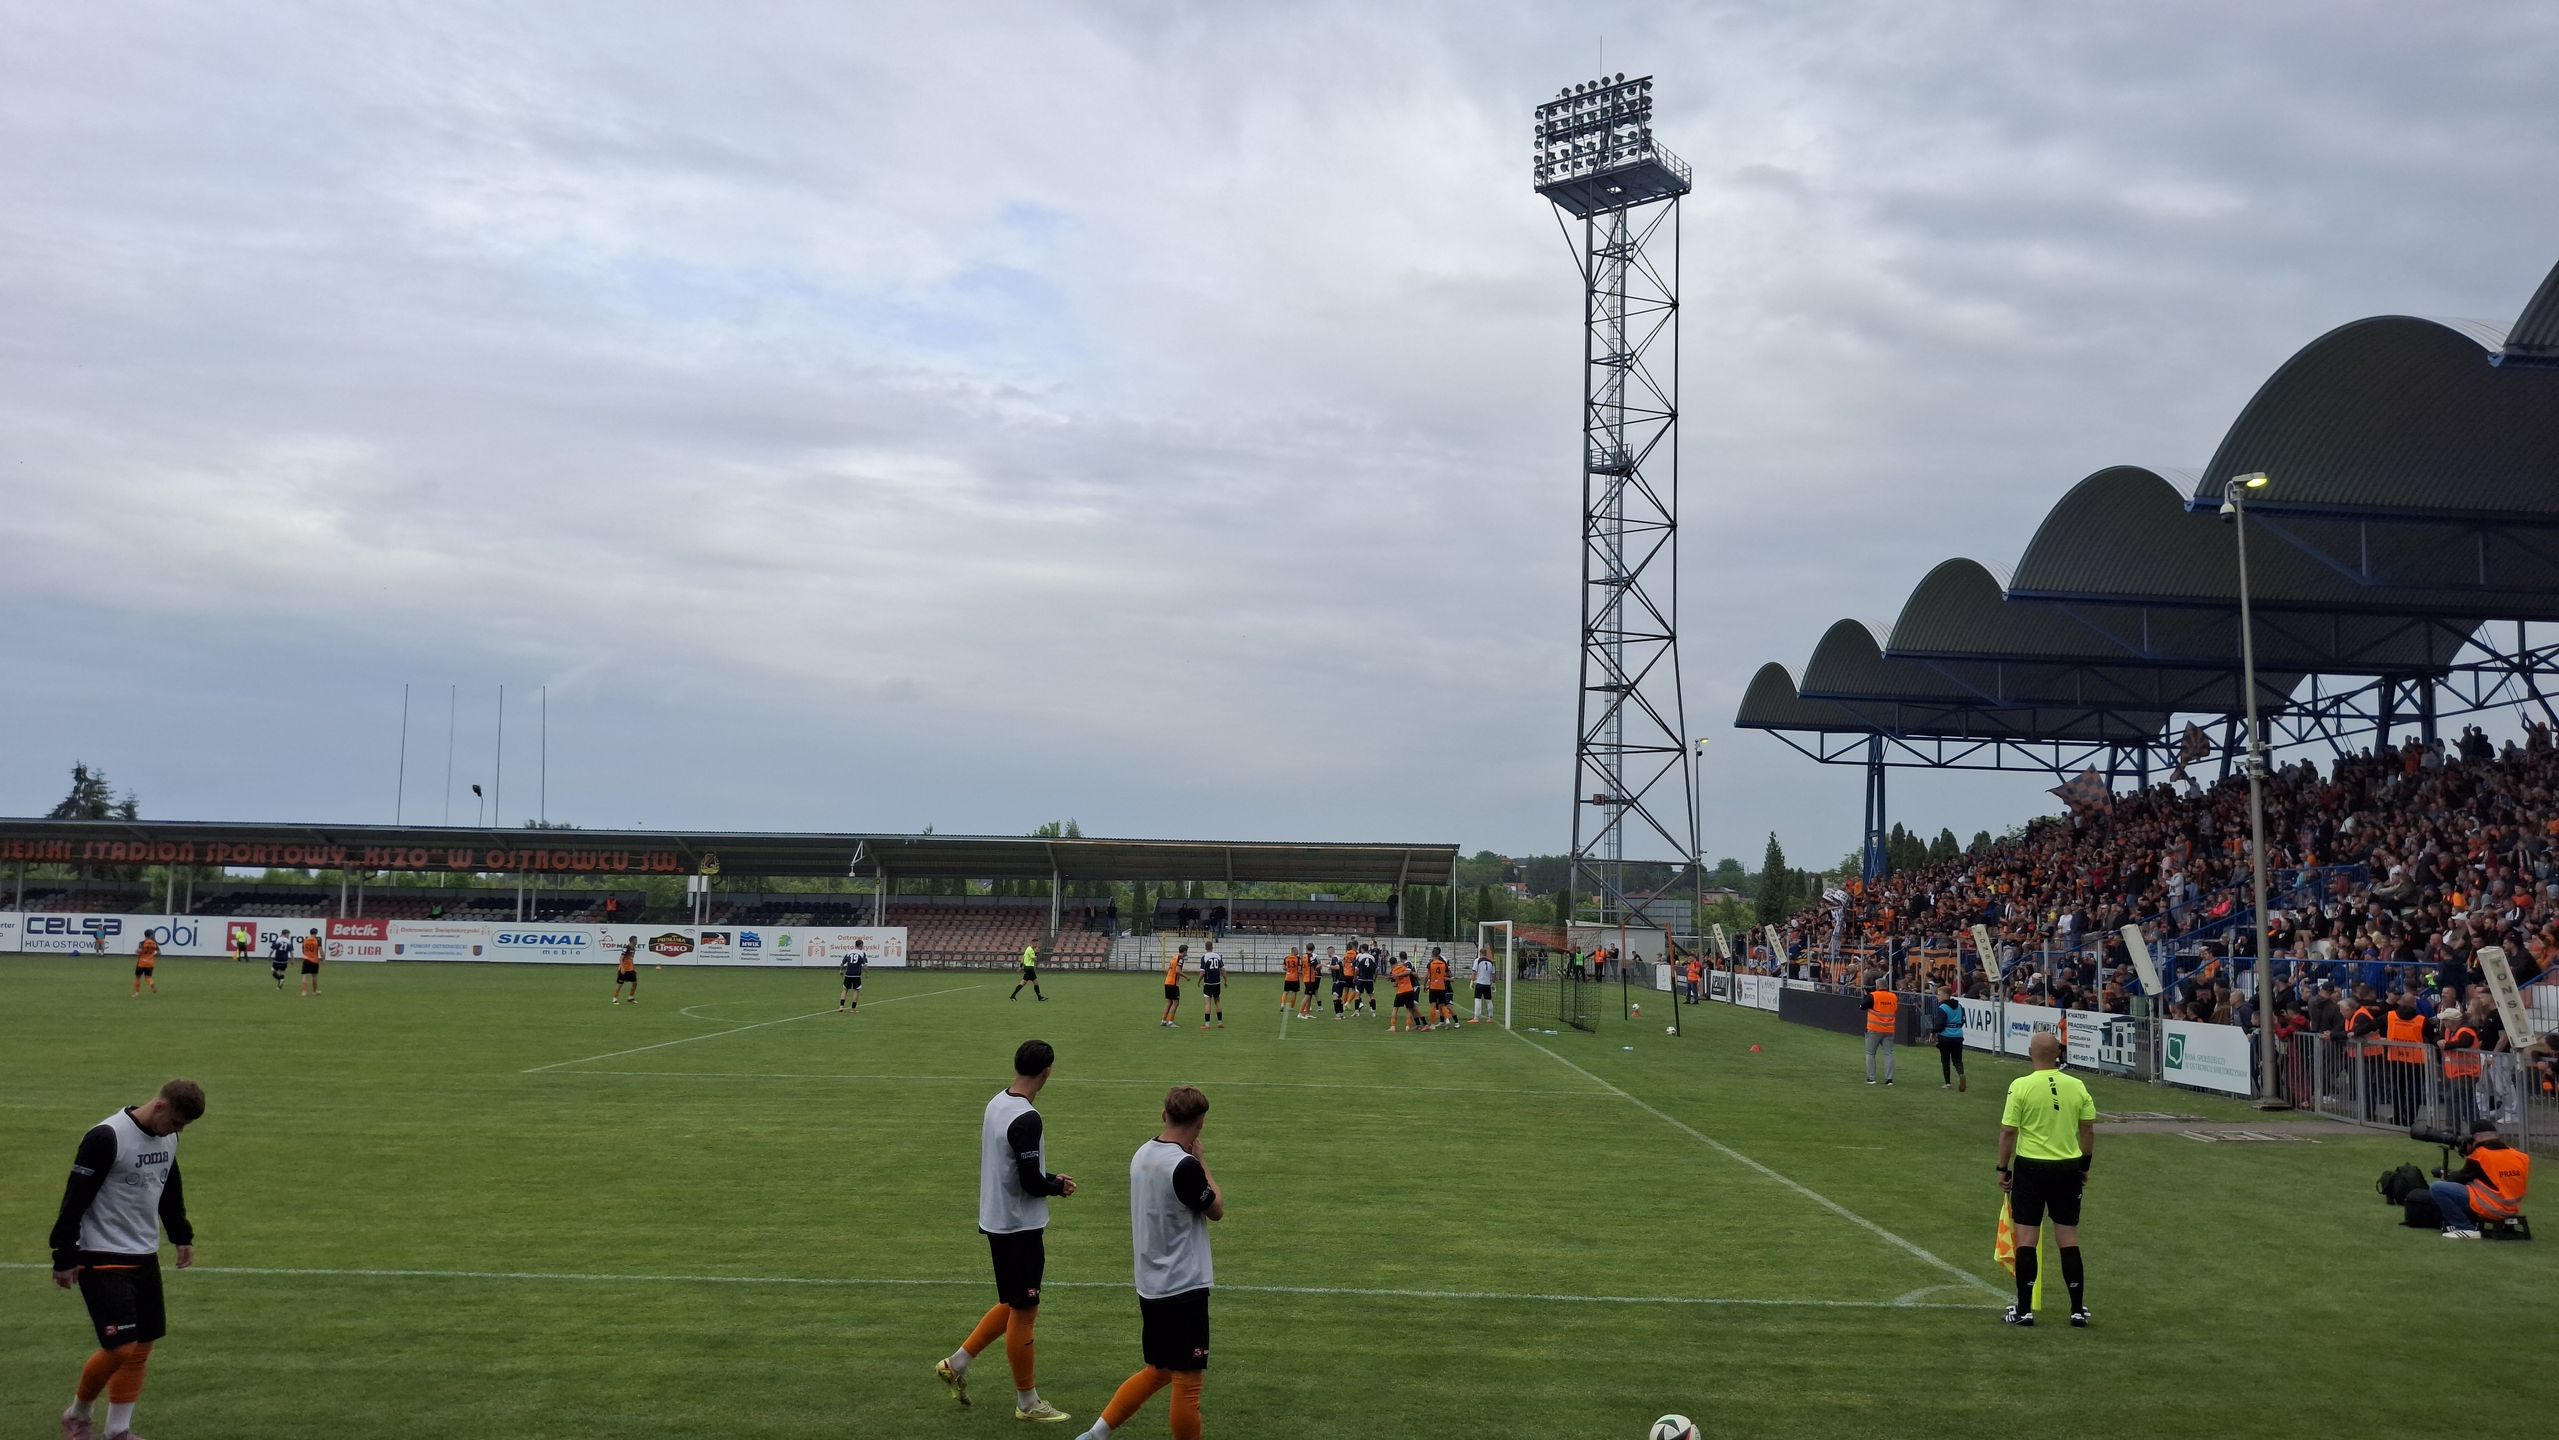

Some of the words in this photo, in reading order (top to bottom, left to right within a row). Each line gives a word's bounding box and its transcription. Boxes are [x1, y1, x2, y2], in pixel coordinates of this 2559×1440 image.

[83, 841, 194, 864] STADION
[206, 843, 347, 866] SPORTOWY
[448, 848, 473, 869] W
[486, 848, 630, 870] OSTROWCU
[333, 923, 379, 937] Betclic
[497, 934, 586, 945] SIGNAL
[25, 940, 50, 948] HUTA
[53, 941, 110, 950] OSTROWC
[347, 944, 354, 954] 3
[358, 944, 382, 956] LIGA
[655, 944, 688, 952] LIPSKO
[849, 953, 859, 963] 19
[1364, 958, 1370, 967] 4
[1209, 958, 1219, 969] 20
[1435, 966, 1441, 974] 4
[2489, 958, 2527, 1035] TONSIL
[2499, 1170, 2521, 1178] PRASA
